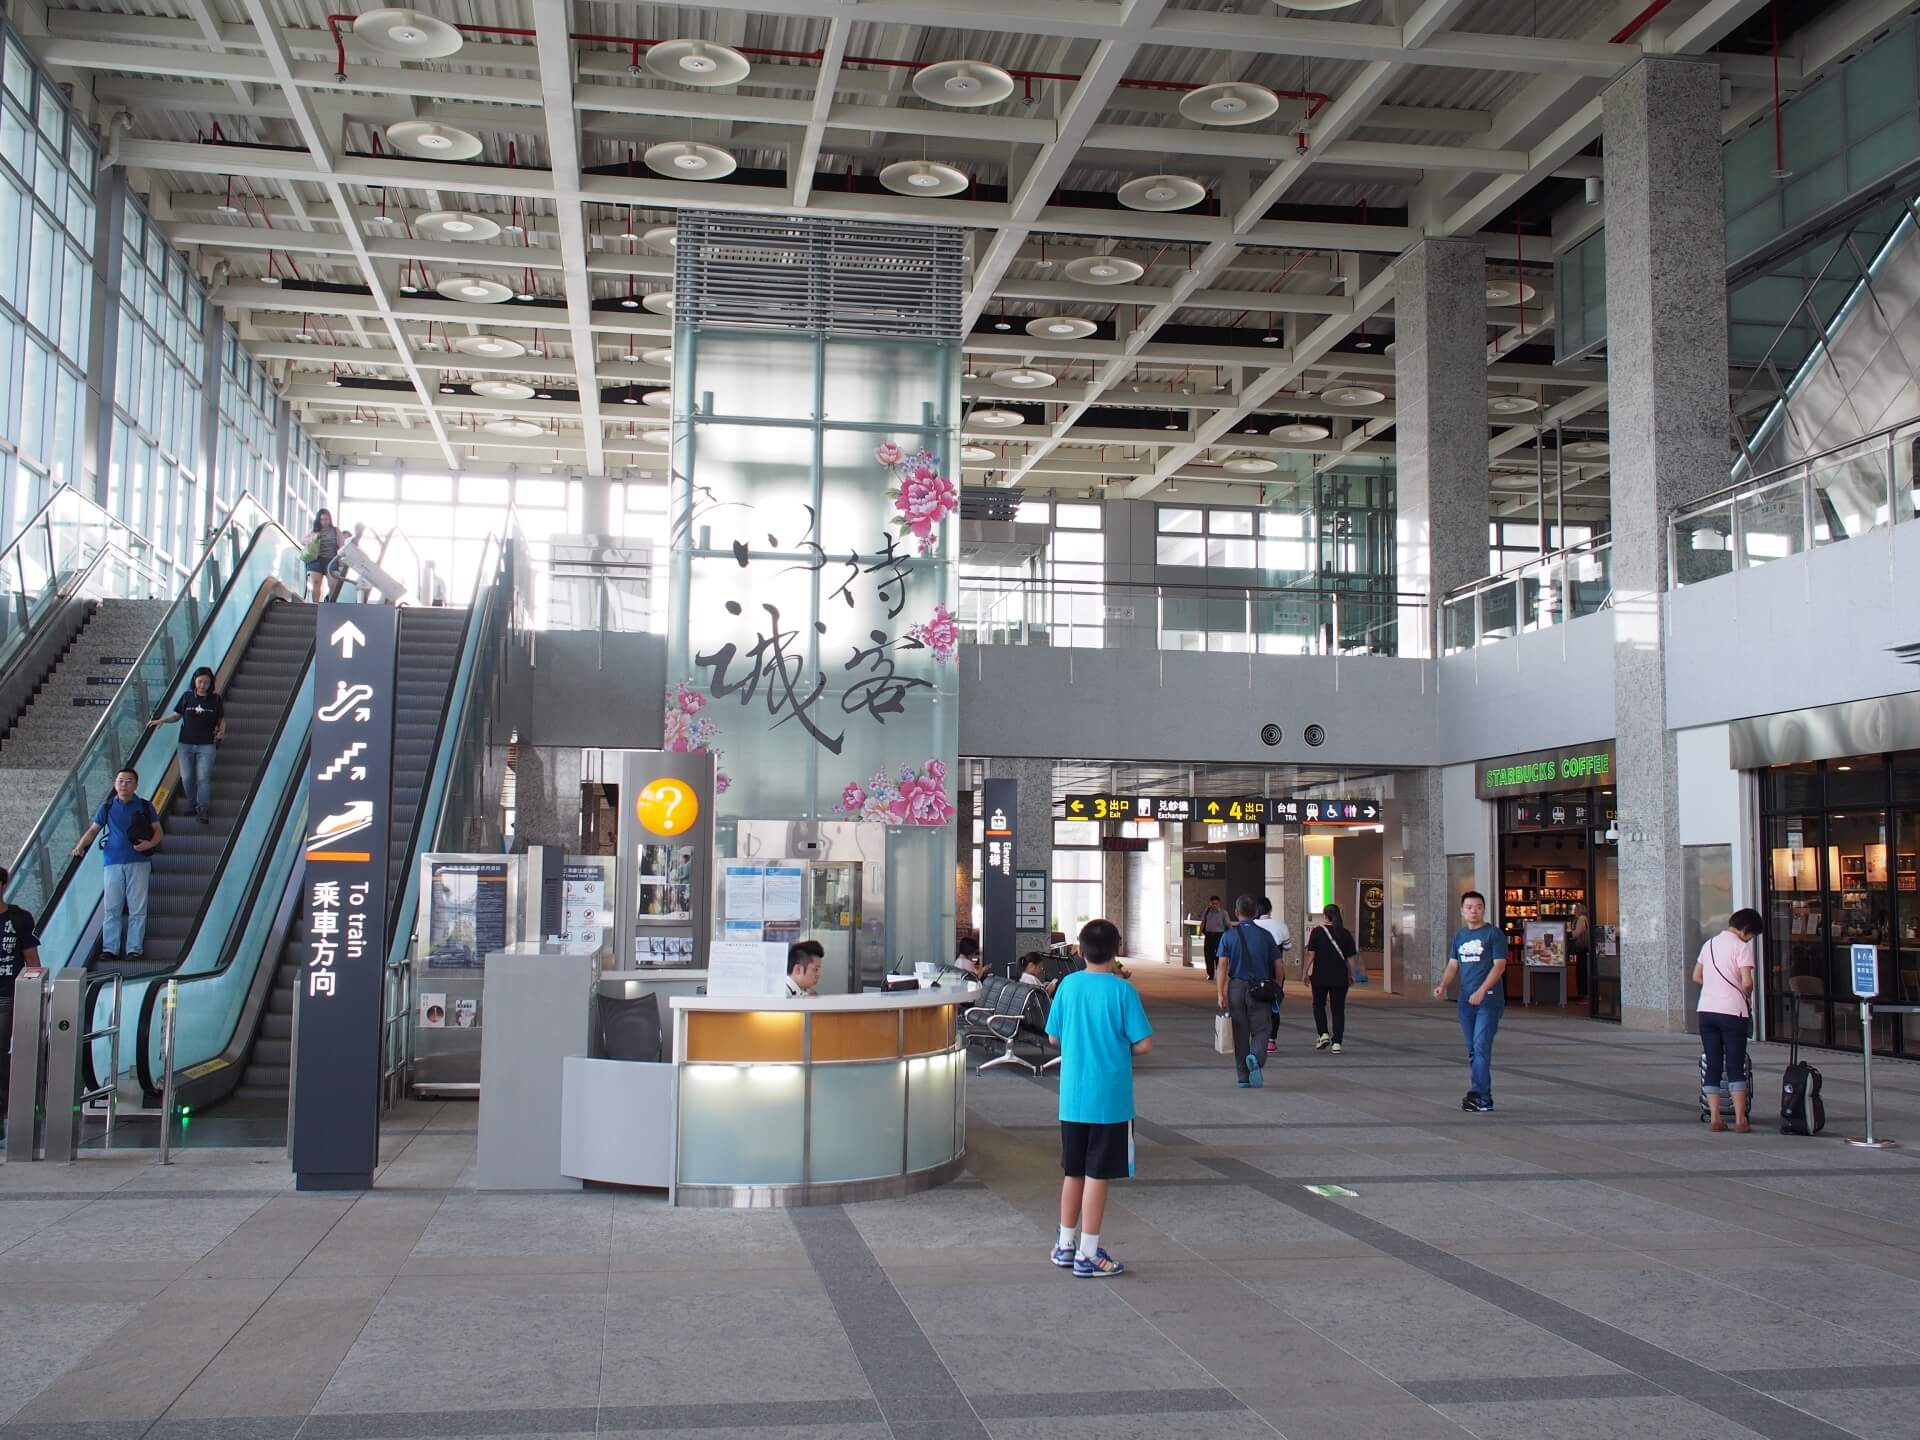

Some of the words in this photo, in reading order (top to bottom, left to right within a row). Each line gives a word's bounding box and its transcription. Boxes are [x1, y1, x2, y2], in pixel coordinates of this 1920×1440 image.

[1486, 762, 1556, 787] STARBUCKS
[1561, 754, 1609, 778] COFFEE
[1093, 798, 1107, 818] 3
[1109, 799, 1129, 811] 出口
[1109, 811, 1121, 819] Exit
[1157, 811, 1189, 820] Exchanger
[1229, 801, 1242, 820] 4
[1245, 802, 1264, 813] 出口
[1245, 813, 1257, 821] Exit
[1285, 814, 1297, 822] TRA
[1003, 842, 1012, 876] Elevator
[349, 881, 369, 906] To
[309, 880, 340, 997] 乘車方向
[347, 913, 367, 958] train
